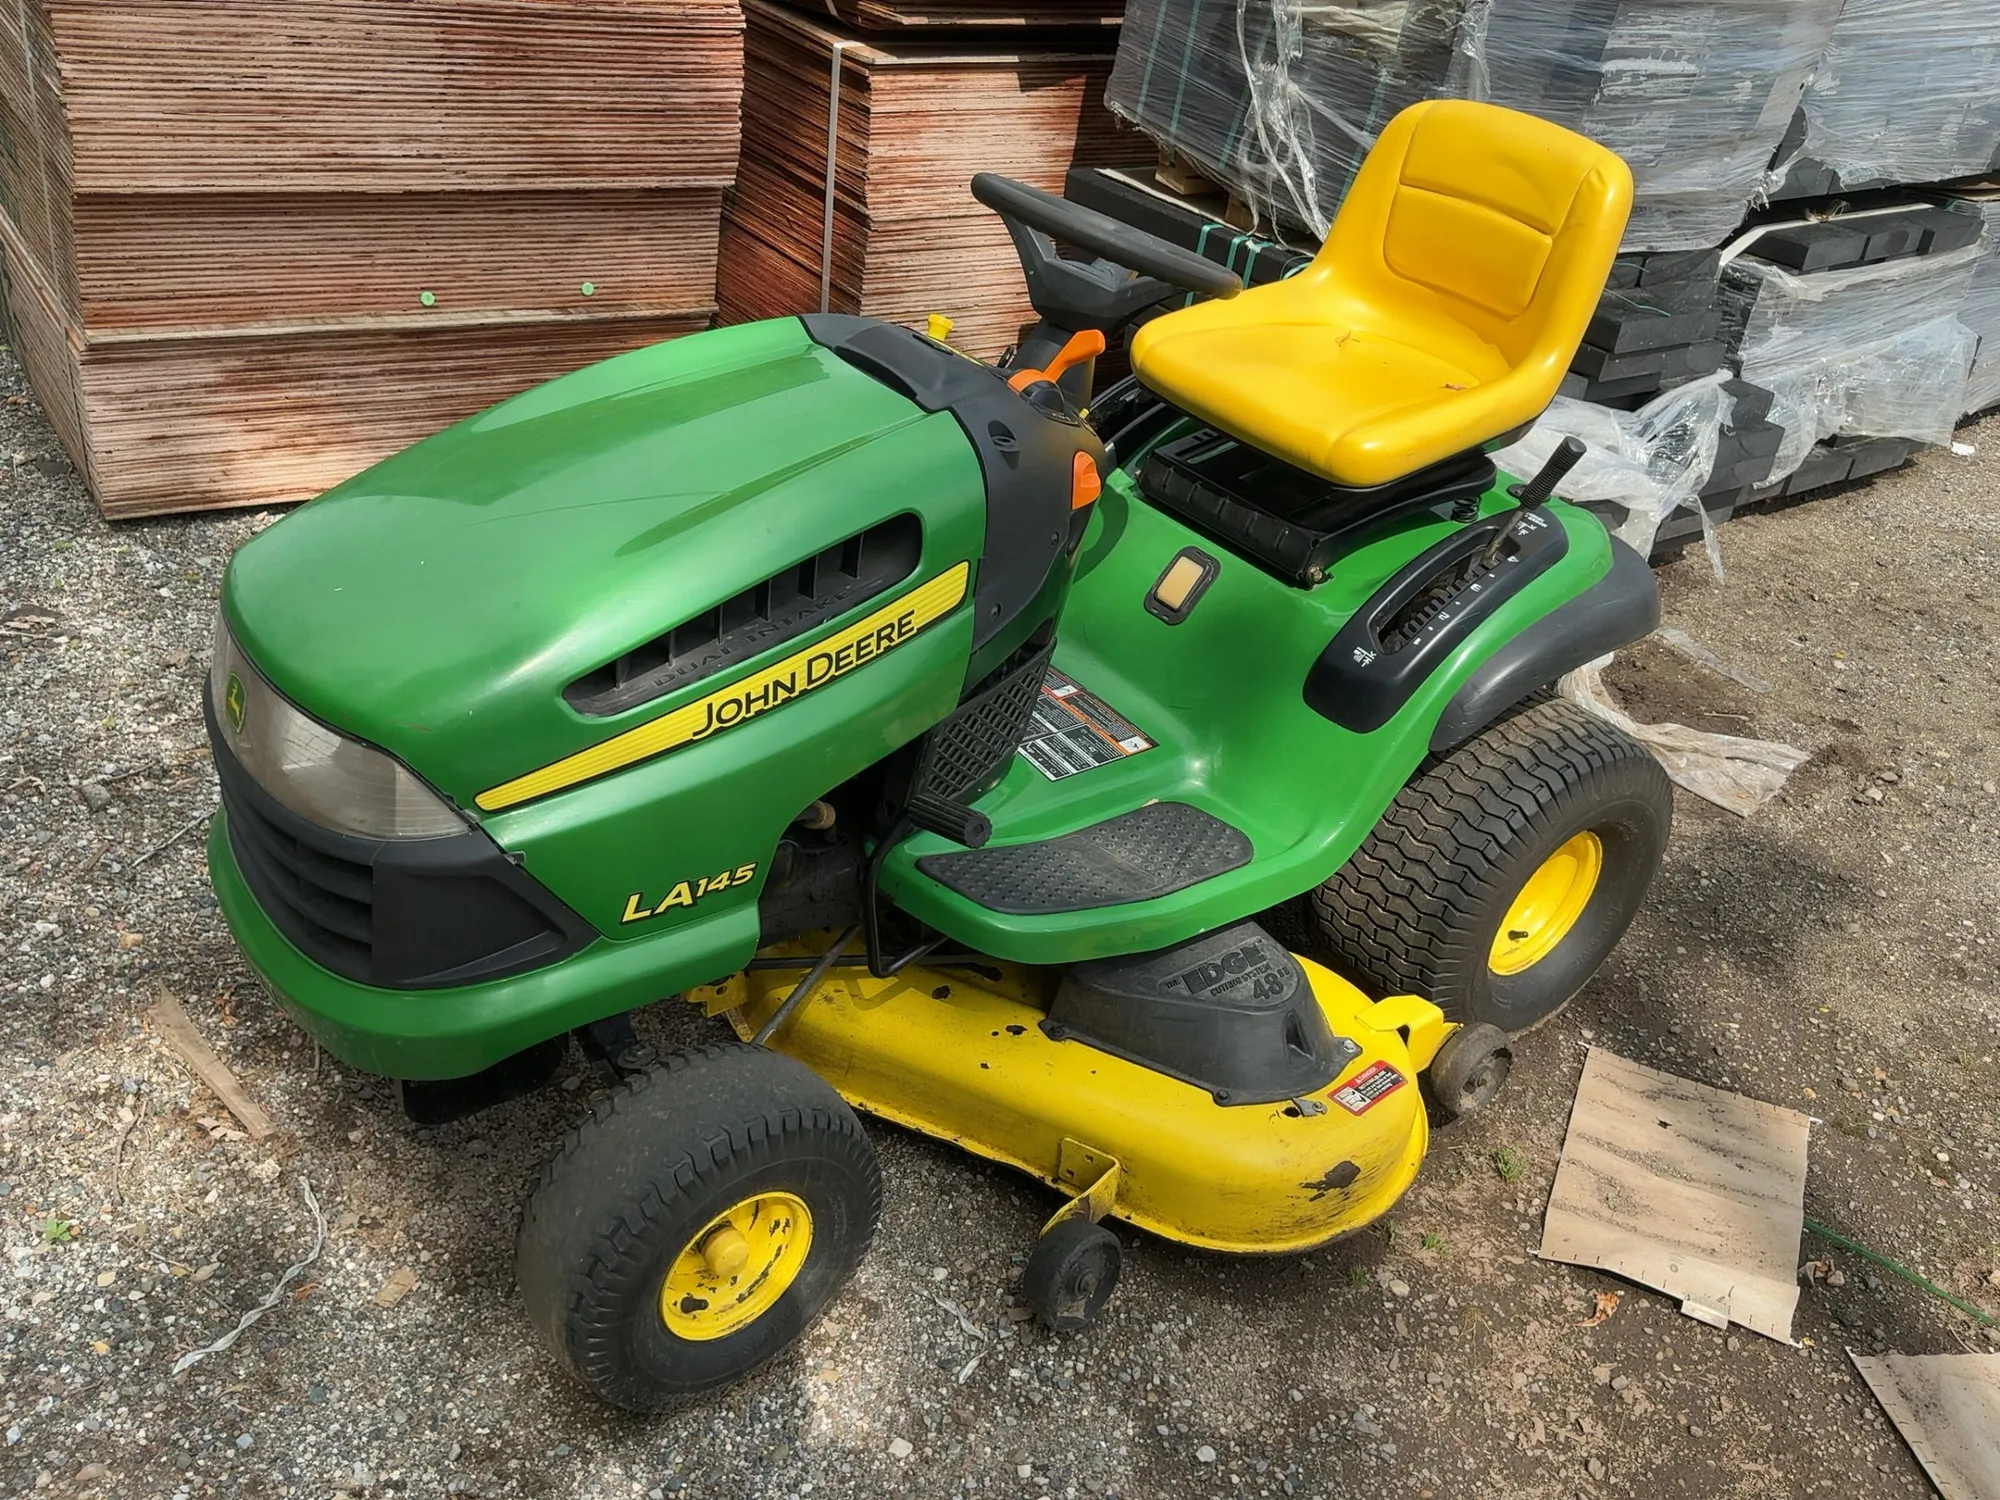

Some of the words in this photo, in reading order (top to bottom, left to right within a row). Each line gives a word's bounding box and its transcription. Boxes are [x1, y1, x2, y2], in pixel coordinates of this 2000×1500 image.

[1438, 611, 1450, 621] 2
[1469, 583, 1482, 592] 3
[1507, 555, 1519, 563] 4
[653, 646, 735, 687] DUAL
[747, 590, 848, 643] INTAKE
[692, 671, 796, 737] JOHN
[807, 609, 915, 687] DEERE
[620, 862, 757, 924] LA145
[1164, 979, 1181, 990] THE
[1181, 944, 1267, 994] EDGE
[1210, 976, 1241, 997] CUTTING
[1242, 962, 1272, 982] SYSTEM
